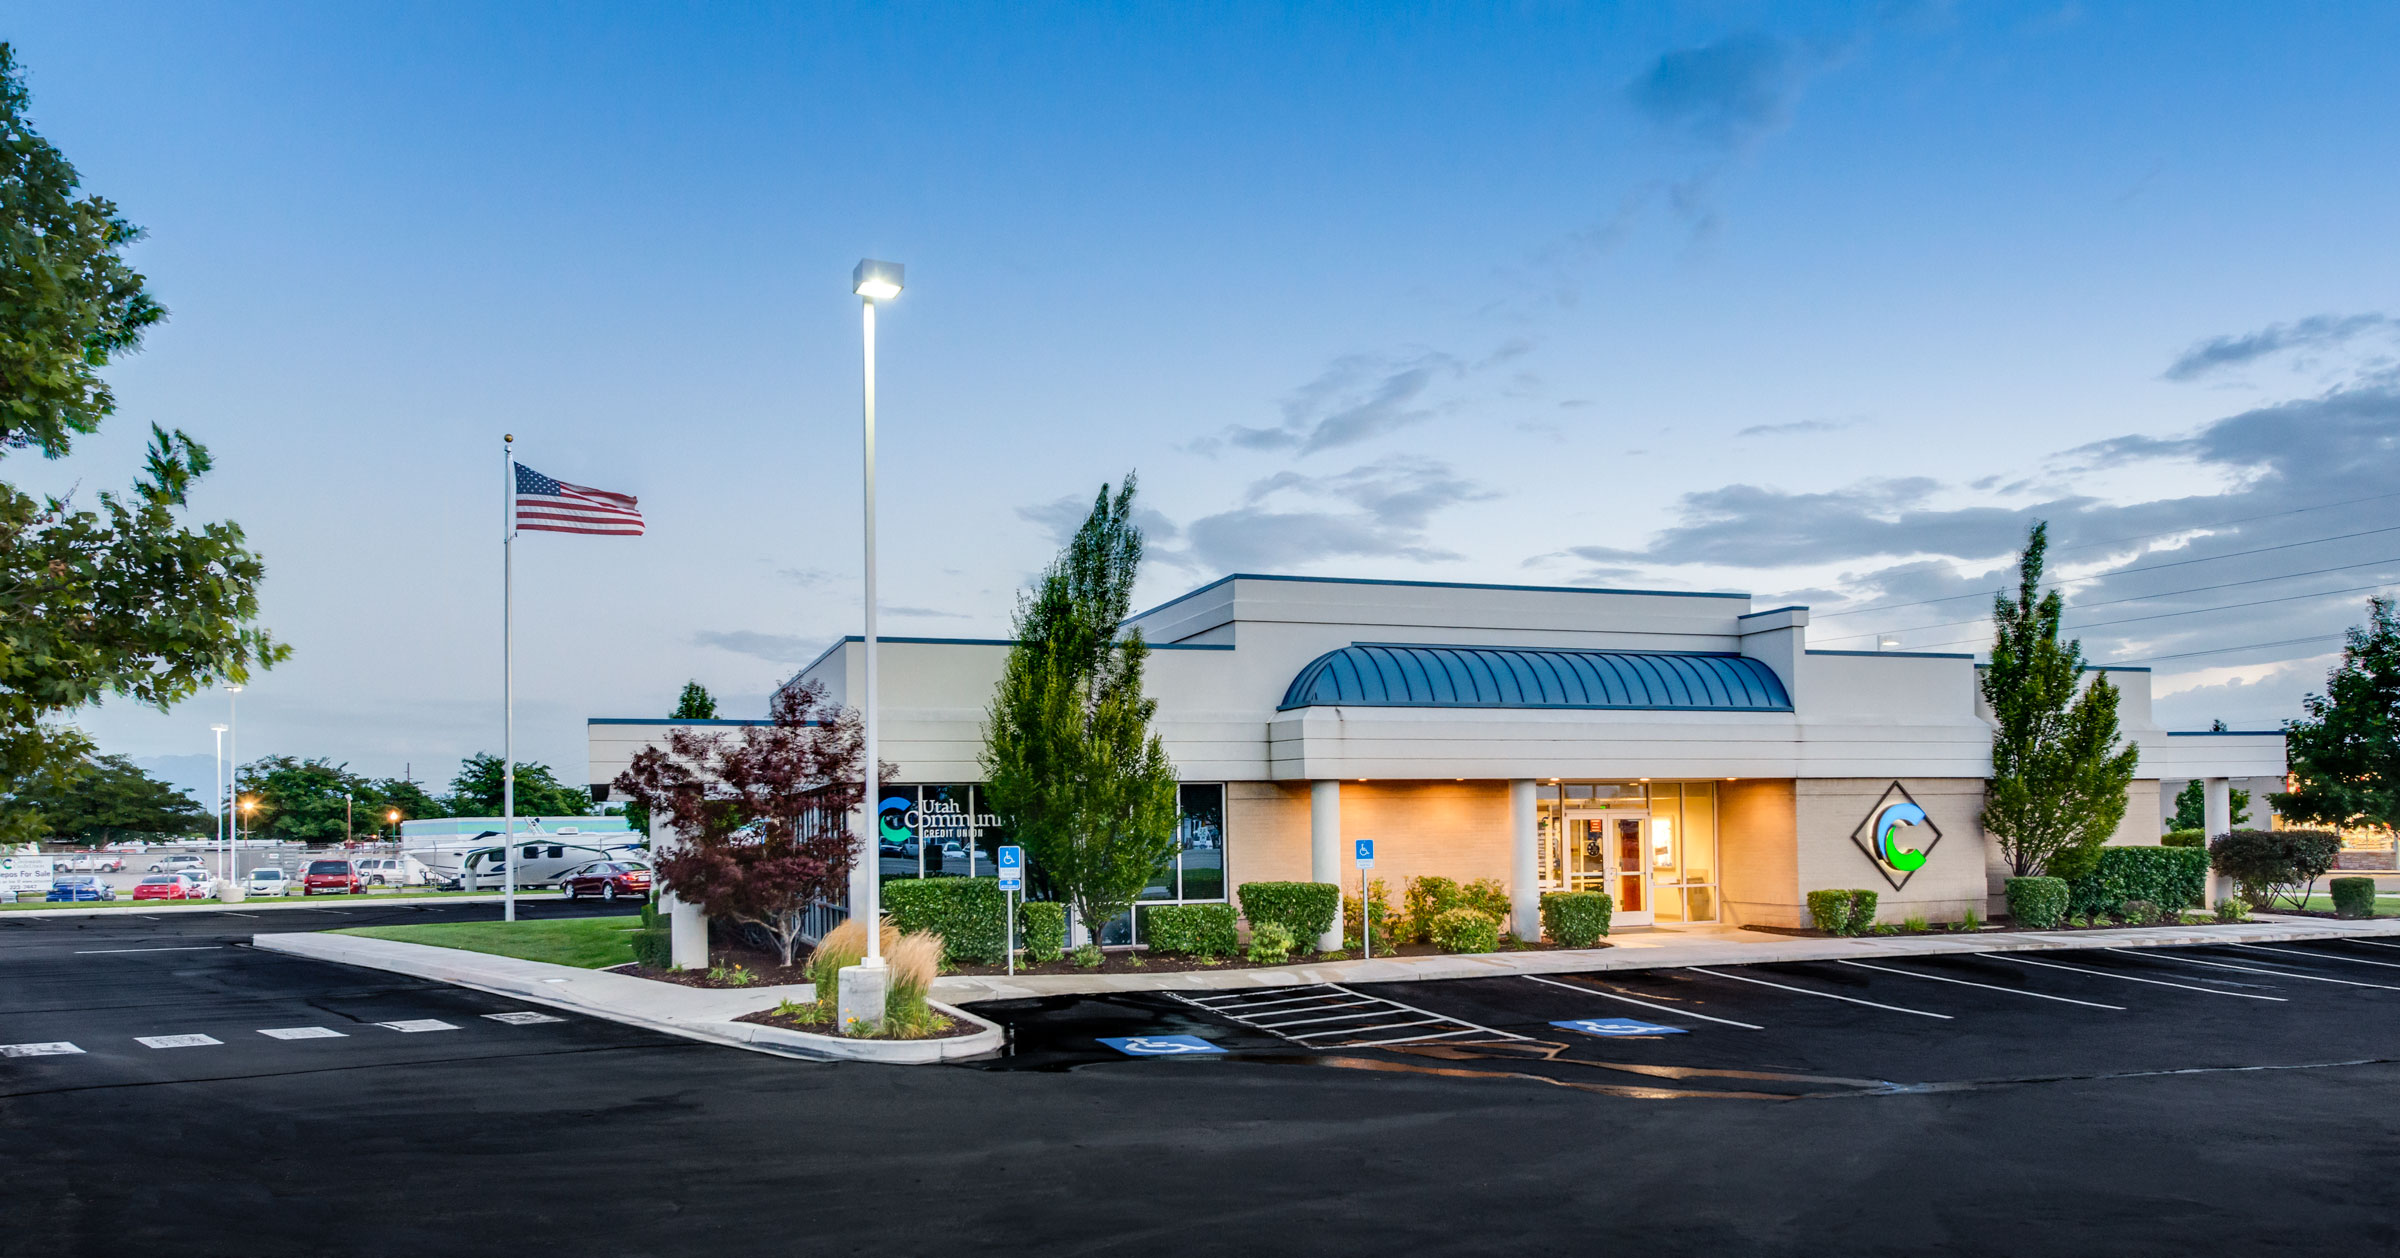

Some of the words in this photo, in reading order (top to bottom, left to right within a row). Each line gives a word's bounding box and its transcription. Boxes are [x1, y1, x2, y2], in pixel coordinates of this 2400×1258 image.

[922, 799, 960, 814] Utah
[904, 810, 1017, 828] Communi
[924, 829, 953, 838] CREDIT
[20, 870, 33, 878] For
